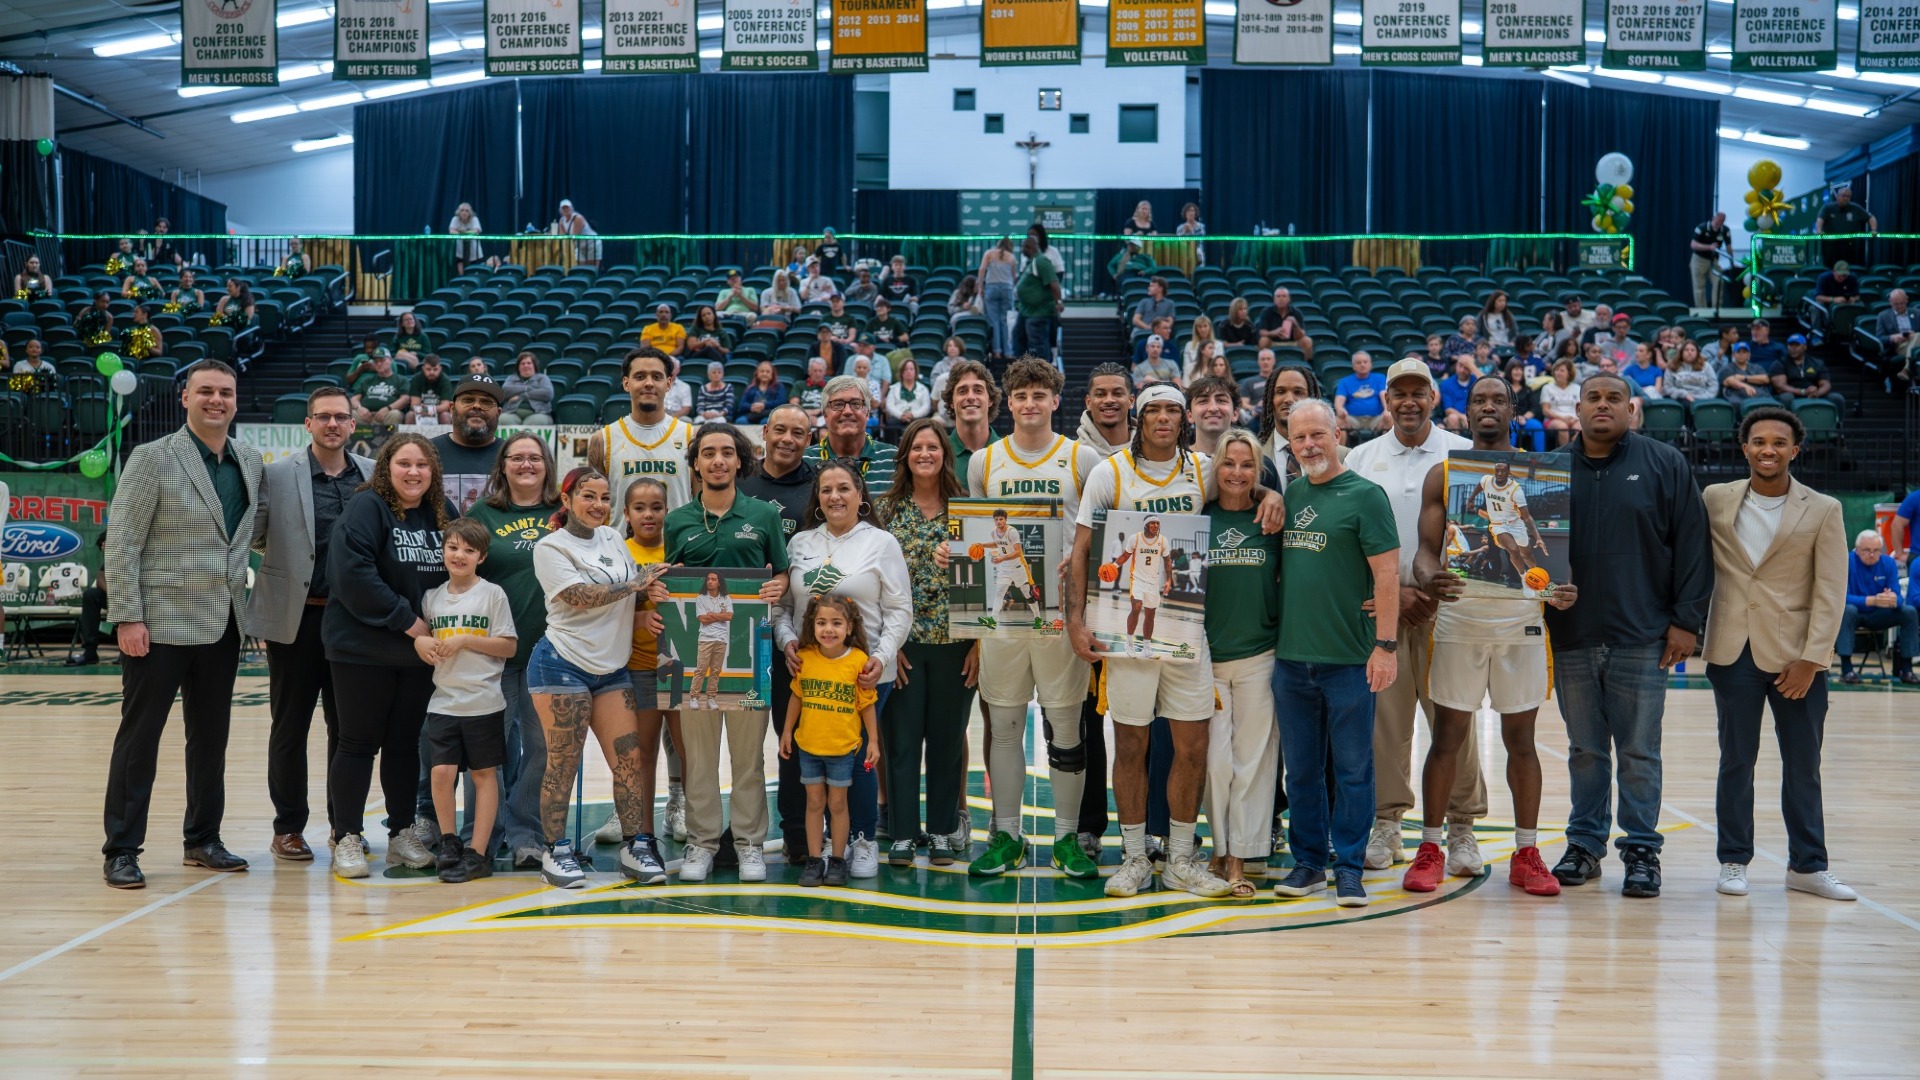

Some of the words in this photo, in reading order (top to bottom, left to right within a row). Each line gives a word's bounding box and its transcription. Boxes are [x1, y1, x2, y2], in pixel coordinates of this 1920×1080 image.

[841, 0, 916, 11] TOURNAMENT
[1399, 3, 1425, 12] 2019
[1490, 4, 1516, 13] 2018
[1612, 6, 1638, 16] 2013
[1644, 6, 1670, 16] 2016
[1675, 6, 1702, 16] 2017
[609, 12, 634, 22] 2013
[638, 12, 663, 21] 2021
[728, 9, 752, 20] 2005
[758, 9, 782, 19] 2013
[788, 9, 812, 18] 2015
[991, 9, 1014, 18] 2014
[1740, 8, 1767, 18] 2009
[1773, 8, 1799, 17] 2016
[1864, 7, 1893, 17] 2014
[1898, 7, 1920, 17] 201
[340, 17, 365, 28] 2016
[370, 17, 394, 28] 2018
[491, 13, 516, 24] 2011
[521, 12, 546, 22] 2016
[838, 15, 861, 25] 2012
[868, 15, 890, 24] 2013
[896, 14, 919, 23] 2014
[1374, 15, 1450, 26] CONFERENCE
[1496, 15, 1573, 26] CONFERENCE
[1616, 18, 1695, 29] CONFERENCE
[216, 23, 243, 34] 2010
[496, 24, 570, 36] CONFERENCE
[614, 23, 688, 35] CONFERENCE
[733, 21, 807, 32] CONFERENCE
[1746, 19, 1825, 31] CONFERENCE
[346, 30, 419, 40] CONFERENCE
[838, 29, 861, 37] 2016
[1377, 28, 1447, 38] CHAMPIONS
[1499, 28, 1570, 39] CHAMPIONS
[1620, 31, 1691, 41] CHAMPIONS
[1749, 32, 1822, 43] CHAMPIONS
[193, 36, 266, 47] CONFERENCE
[500, 36, 567, 49] CHAMPIONS
[617, 36, 685, 47] CHAMPIONS
[737, 34, 804, 44] CHAMPIONS
[349, 42, 416, 53] CHAMPIONS
[197, 48, 264, 60] CHAMPIONS
[985, 52, 1024, 62] WOMEN'S
[1025, 51, 1077, 60] BASKETBALL
[1124, 50, 1189, 62] VOLLEYBALL
[1363, 52, 1389, 62] MEN'S
[1391, 52, 1418, 62] CROSS
[1421, 52, 1459, 62] COUNTRY
[1490, 52, 1522, 62] MEN'S
[1525, 52, 1578, 62] LACROSSE
[490, 60, 537, 72] WOMEN'S
[539, 60, 578, 70] SOCCER
[606, 60, 635, 70] MEN'S
[638, 58, 696, 70] BASKETBALL
[731, 56, 764, 66] MEN'S
[766, 56, 808, 66] SOCCER
[833, 58, 863, 69] MEN'S
[866, 57, 925, 68] BASKETBALL
[1628, 55, 1680, 66] SOFTBALL
[1750, 56, 1817, 66] VOLLEYBALL
[1860, 57, 1895, 67] WOMEN'S
[348, 65, 379, 75] MEN'S
[382, 65, 417, 75] TENNIS
[189, 73, 220, 83] MEN'S
[223, 73, 273, 83] LACROSSE
[1044, 212, 1063, 220] THE
[1042, 220, 1066, 228] DECK
[1591, 246, 1609, 254] THE
[1775, 246, 1794, 254] THE
[1589, 255, 1613, 264] DECK
[1772, 255, 1797, 264] DECK
[624, 460, 677, 476] LIONS
[1000, 480, 1060, 496] LIONS
[1134, 496, 1193, 513] LIONS
[496, 518, 535, 536] SAINT
[1, 528, 60, 554] Ford
[393, 528, 429, 548] SAINT
[1306, 532, 1327, 545] LEO
[513, 540, 537, 551] Mo
[397, 547, 444, 563] UNIVERS
[1239, 548, 1265, 560] LEO
[1145, 556, 1151, 566] 2
[430, 615, 458, 629] SAINT
[462, 615, 489, 628] LEO
